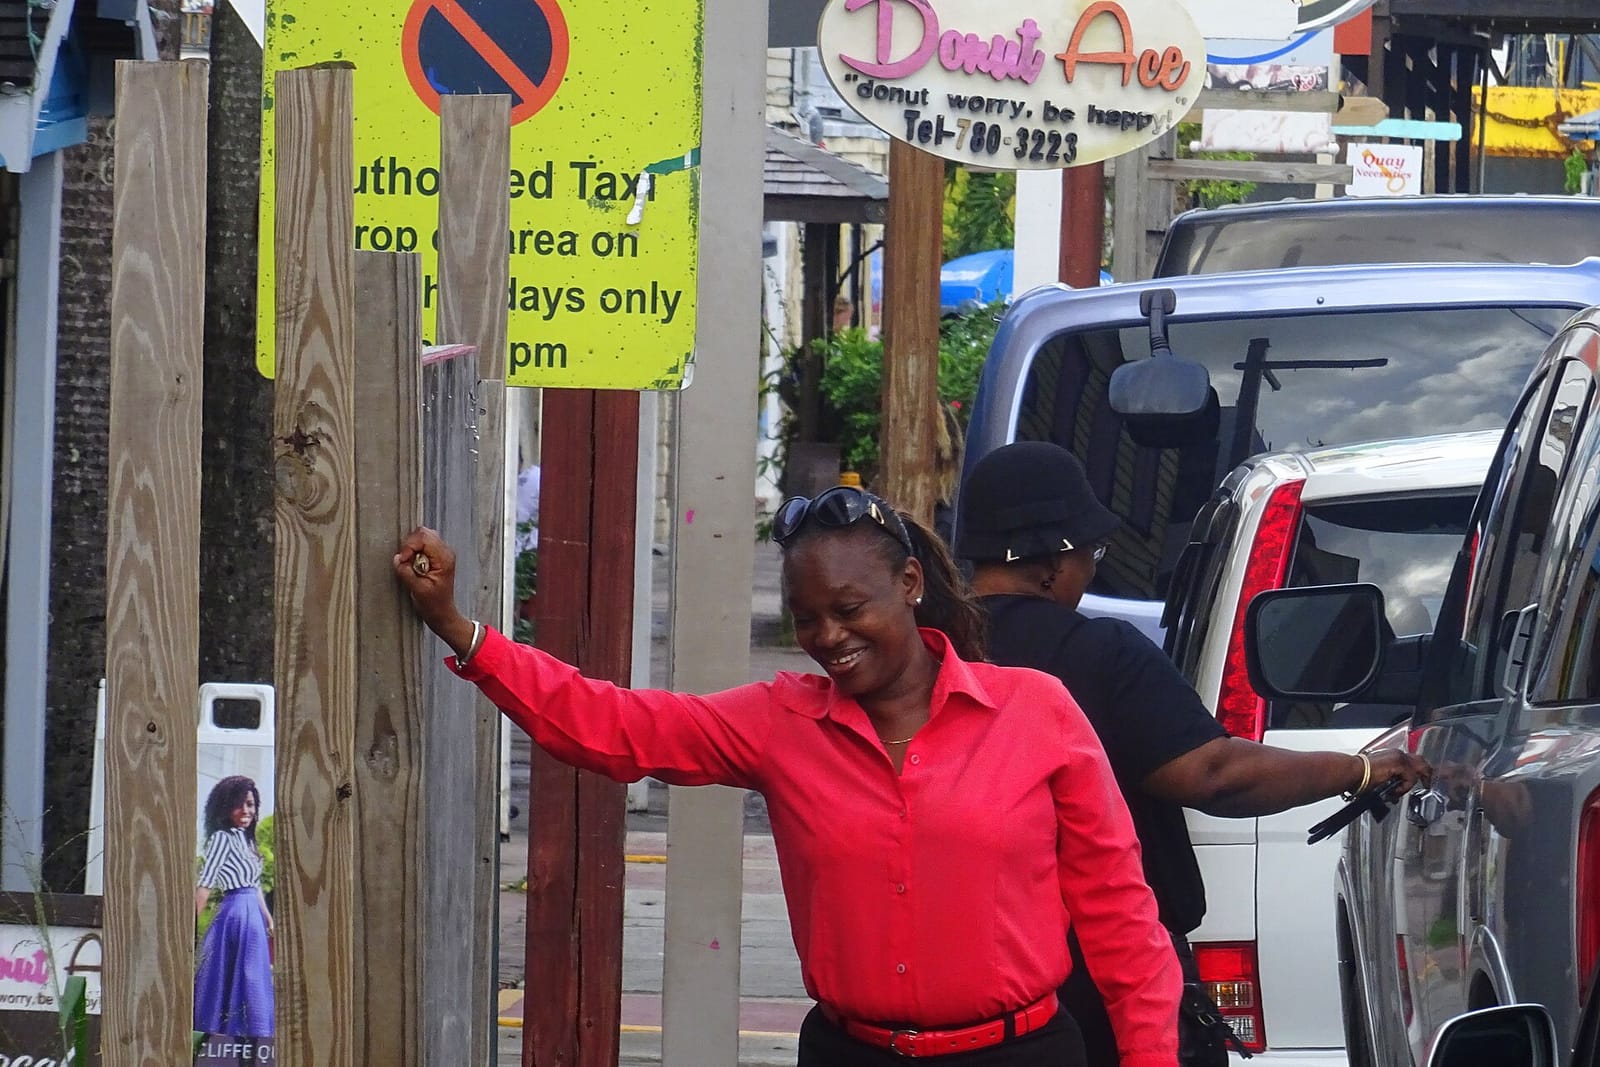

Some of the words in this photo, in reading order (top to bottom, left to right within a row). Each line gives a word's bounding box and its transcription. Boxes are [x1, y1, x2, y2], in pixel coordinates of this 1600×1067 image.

[839, 0, 1045, 84] Donut
[1054, 0, 1191, 91] Ace
[947, 93, 1033, 120] worry,
[1043, 100, 1076, 122] be
[1363, 153, 1405, 169] Quay
[569, 161, 656, 202] Taxi
[355, 225, 418, 252] rop
[591, 231, 638, 257] on
[600, 281, 682, 324] only
